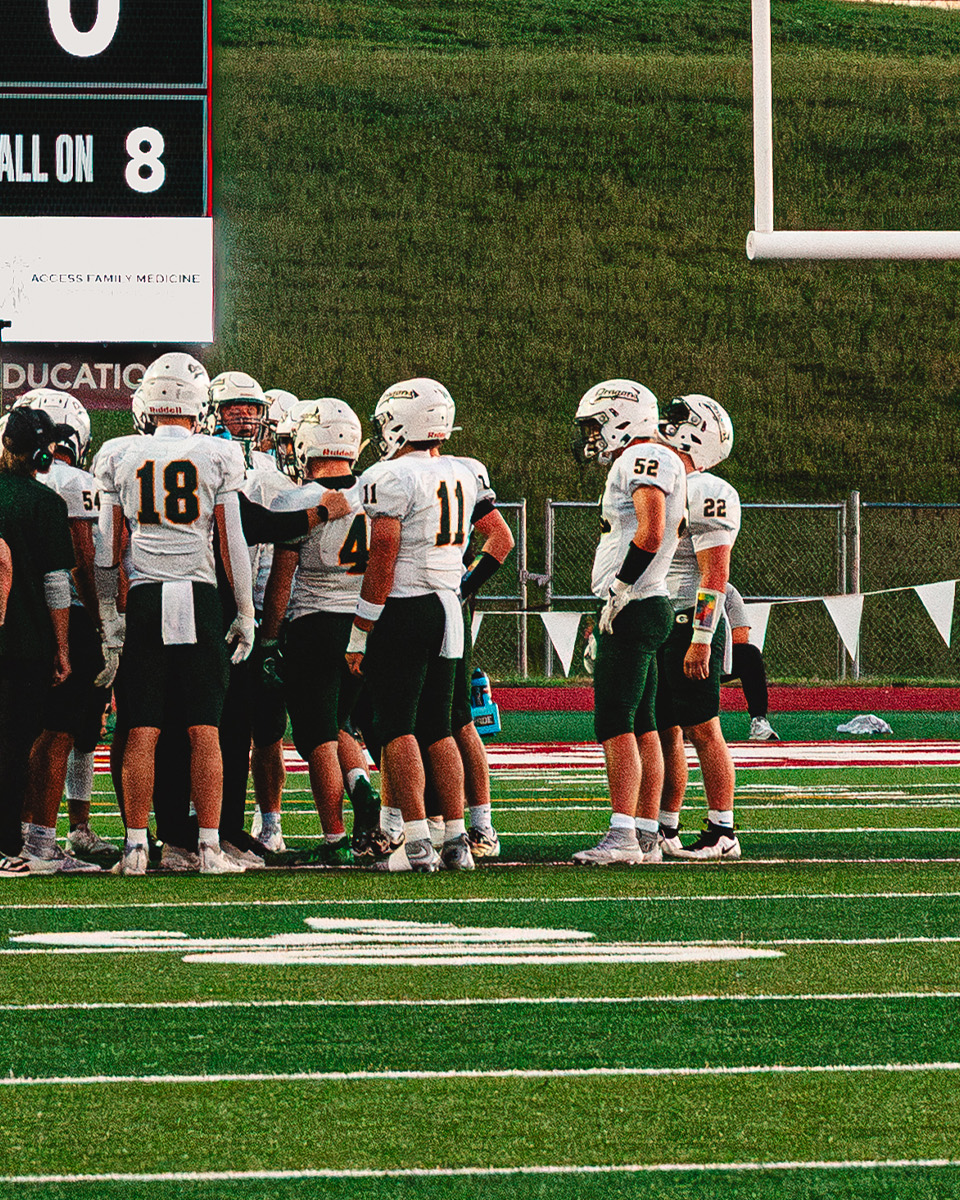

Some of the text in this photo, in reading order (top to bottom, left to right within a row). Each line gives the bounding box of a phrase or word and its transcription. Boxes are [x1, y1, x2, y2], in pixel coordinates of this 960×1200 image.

[55, 133, 94, 183] ON
[124, 125, 166, 193] 8
[31, 273, 201, 284] ACCESS FAMILY MEDICINE
[633, 457, 660, 477] 52
[81, 490, 101, 512] 54
[136, 459, 201, 525] 18
[362, 483, 378, 504] 11
[434, 479, 465, 548] 11
[702, 497, 727, 517] 22
